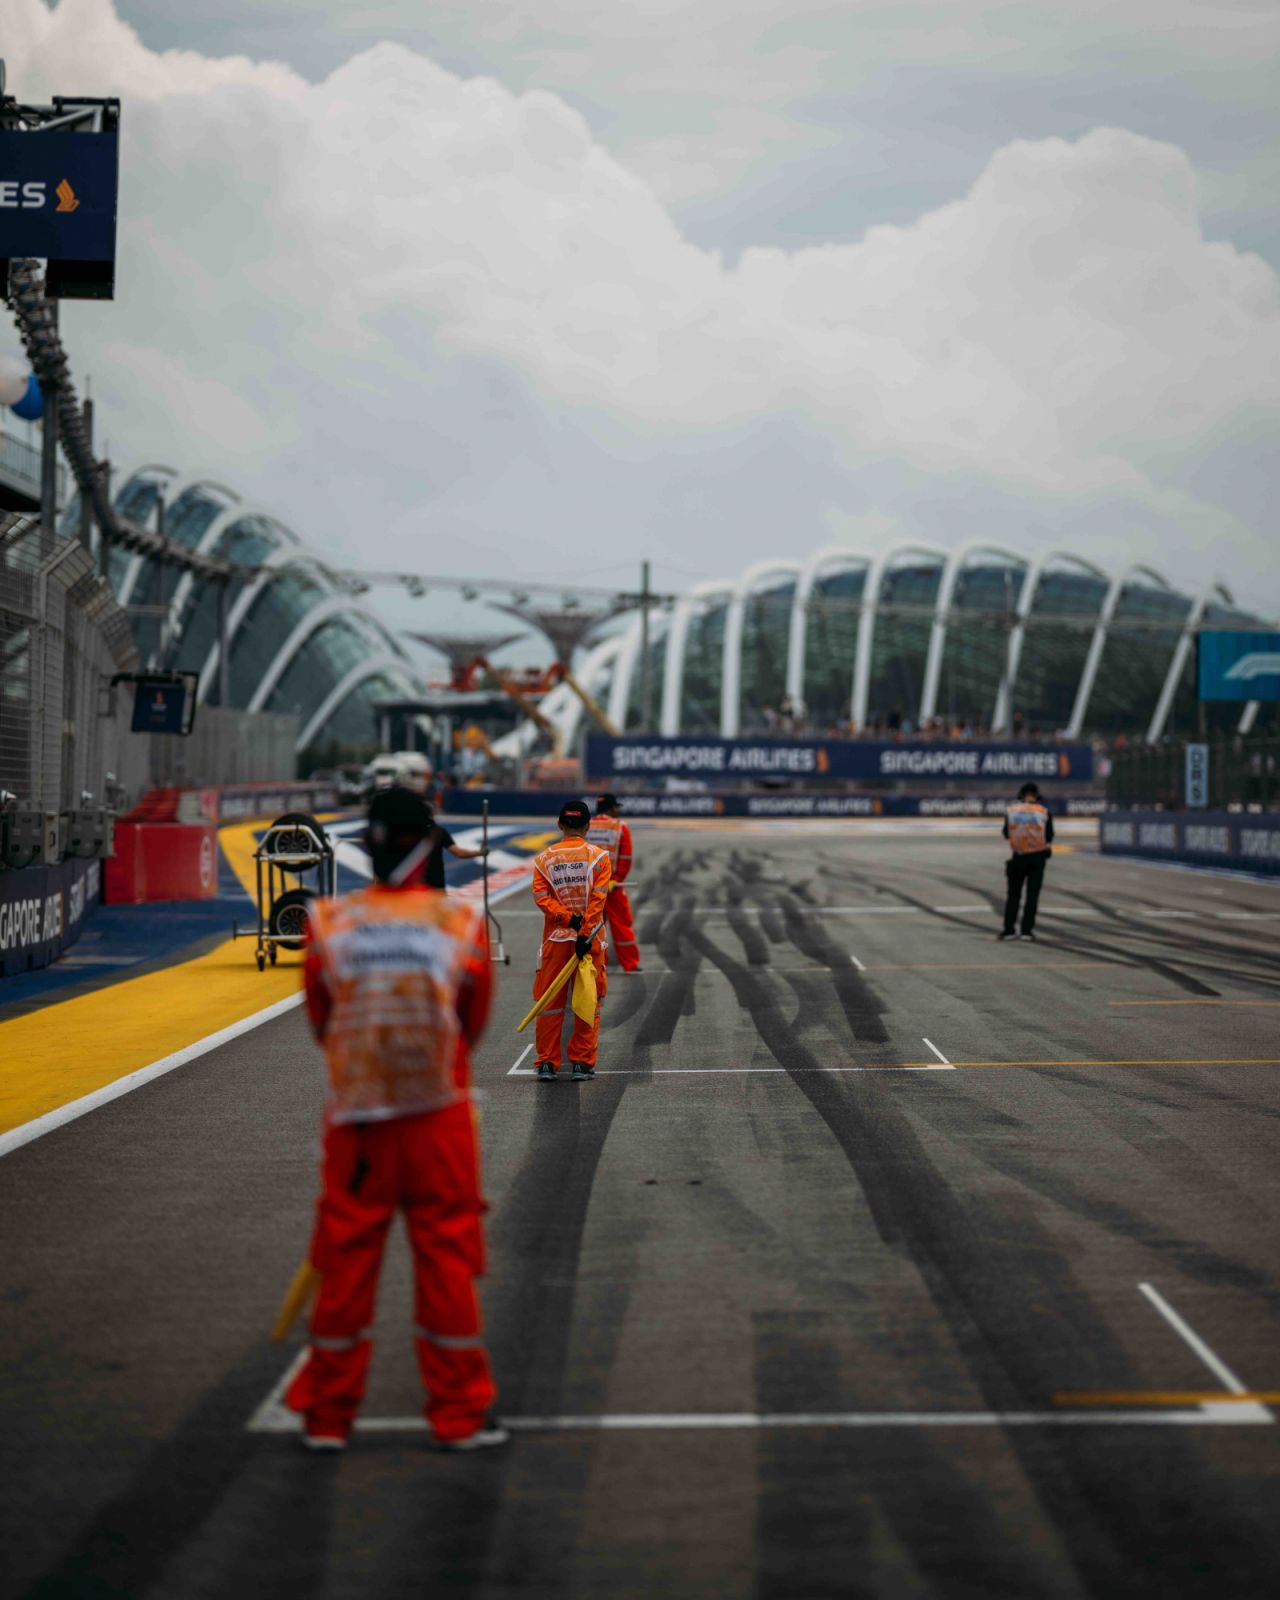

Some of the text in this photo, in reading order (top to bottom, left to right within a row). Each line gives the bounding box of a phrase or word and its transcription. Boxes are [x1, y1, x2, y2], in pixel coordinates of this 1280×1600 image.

[612, 746, 815, 772] SINGAPORE AIRLINES
[880, 751, 1058, 775] SINGAPORE AIRLINES
